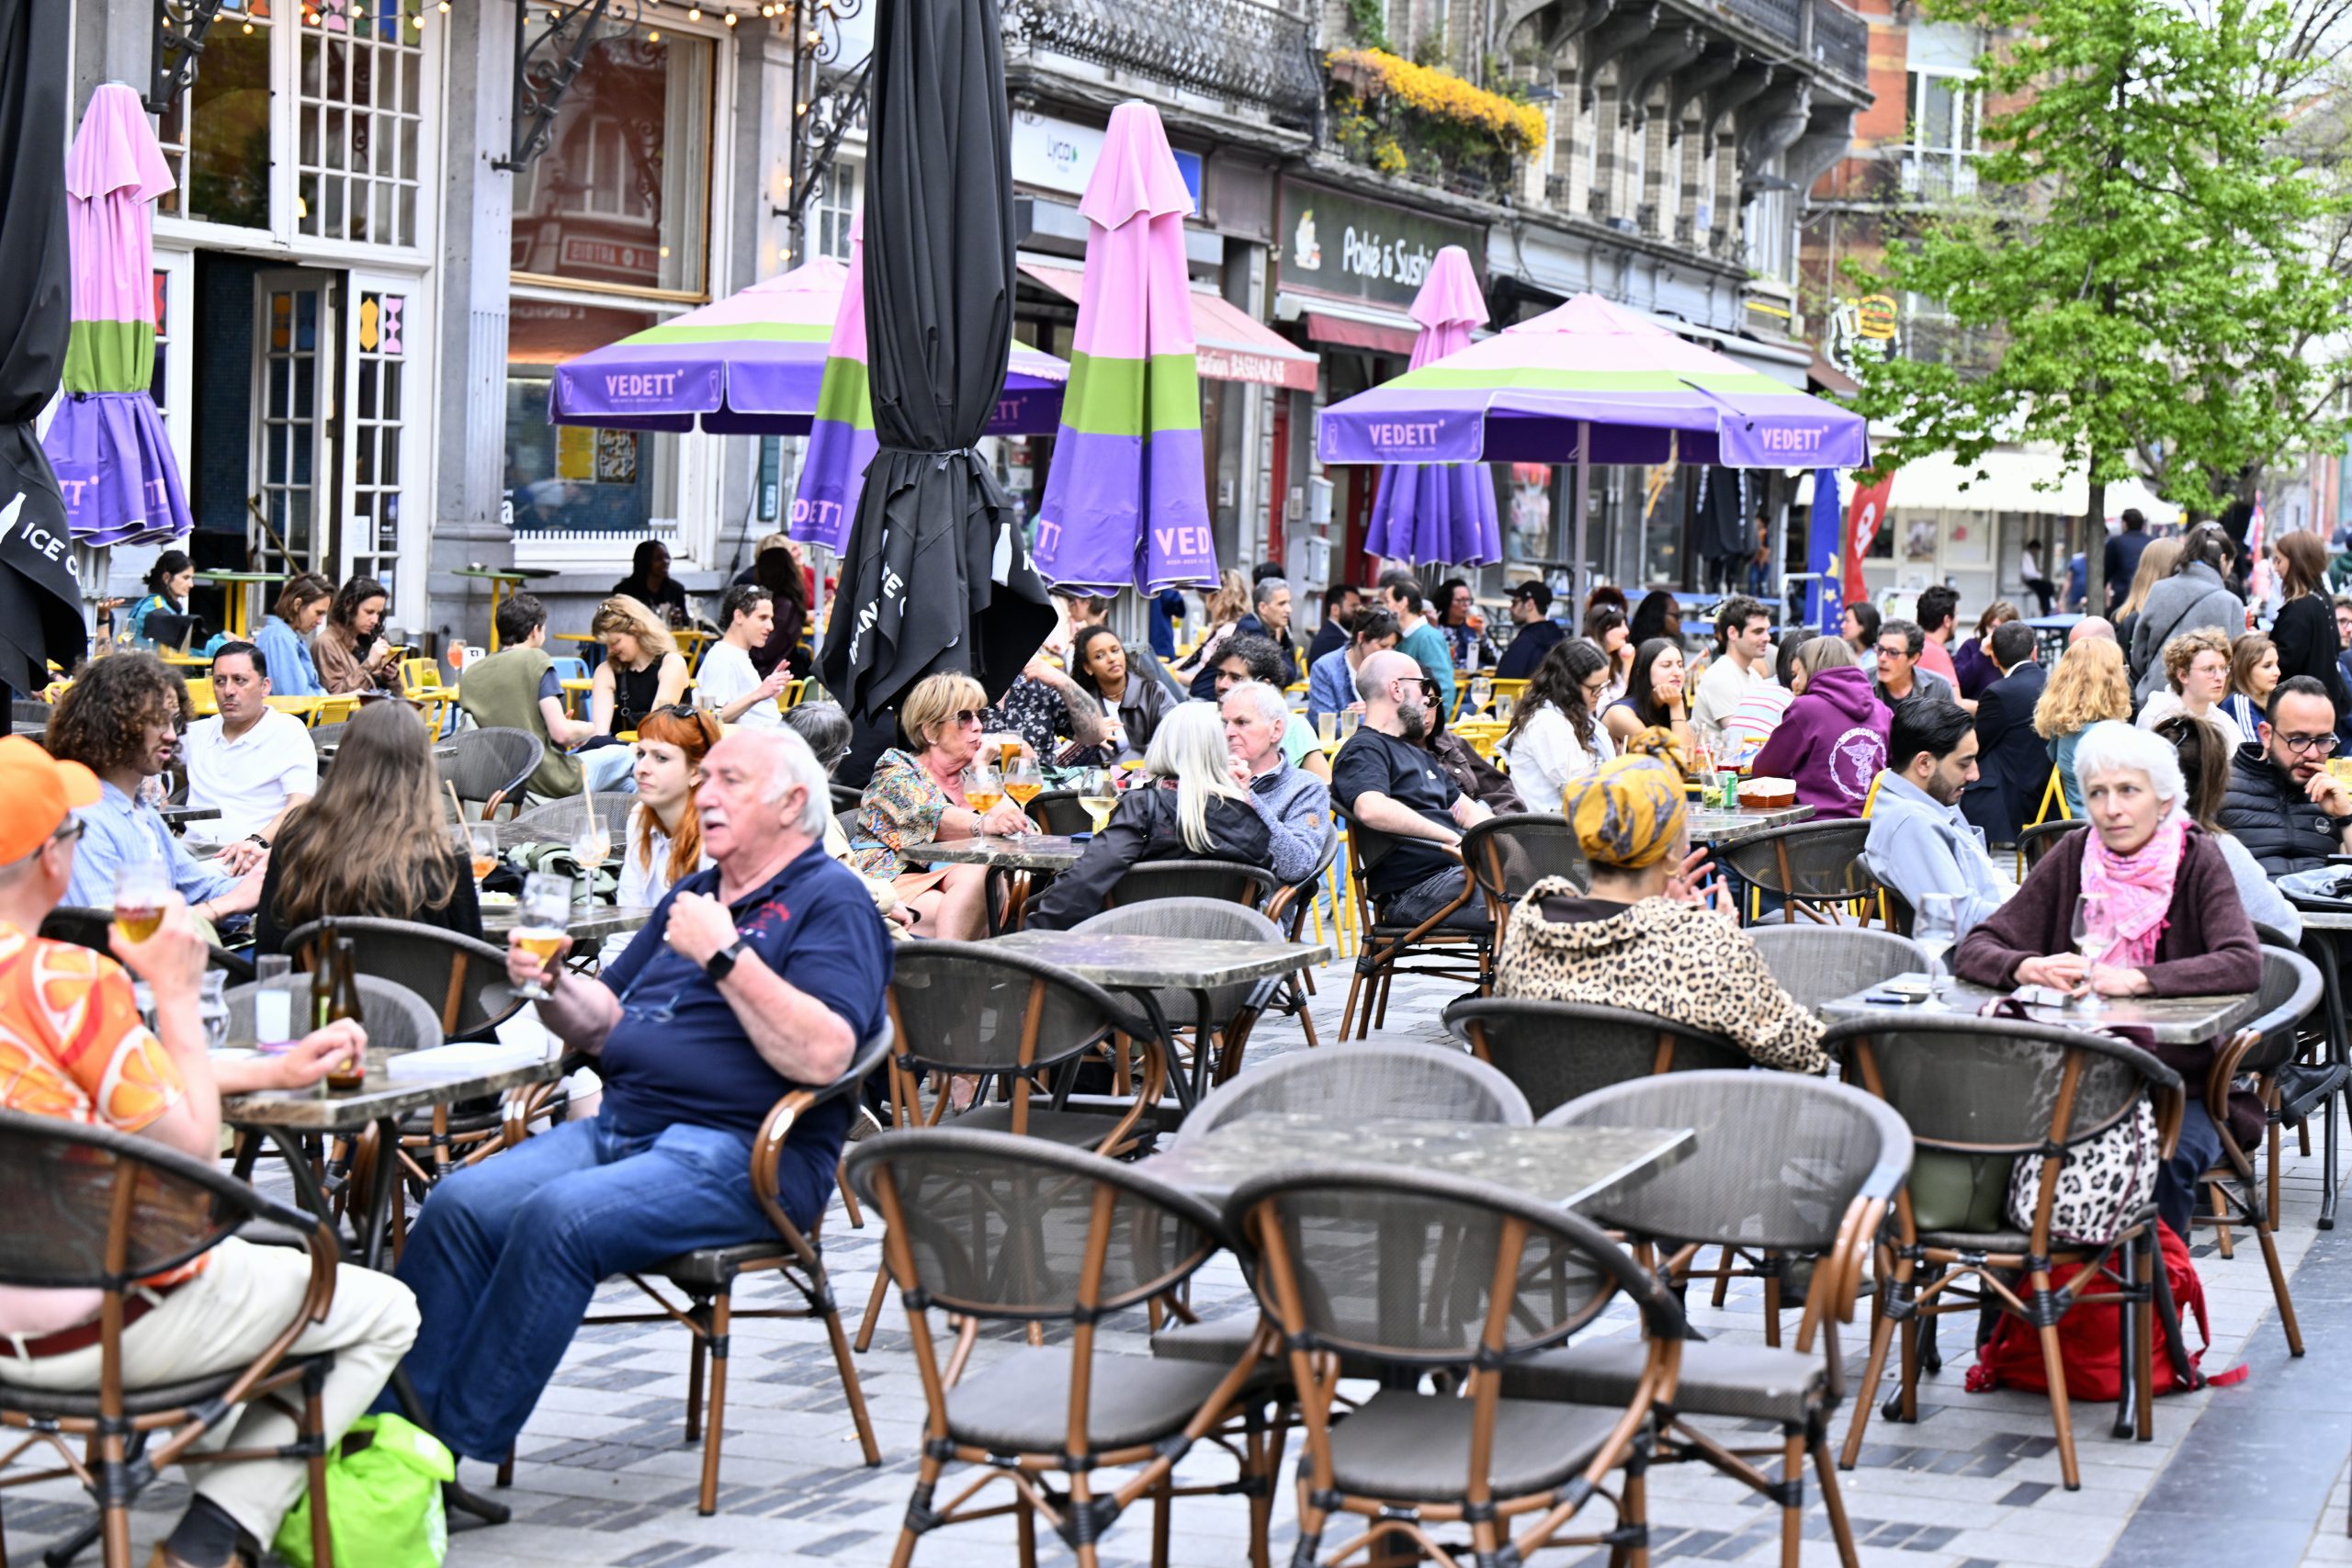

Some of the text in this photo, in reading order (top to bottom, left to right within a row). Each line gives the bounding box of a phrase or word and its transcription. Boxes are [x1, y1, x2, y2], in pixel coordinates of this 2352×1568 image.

[1342, 226, 1381, 278] Poké
[1394, 238, 1434, 286] Sushi
[605, 373, 676, 397] VEDETT
[1368, 423, 1438, 446] VEDETT
[1761, 427, 1823, 450] VEDETT
[21, 522, 66, 562] ICE
